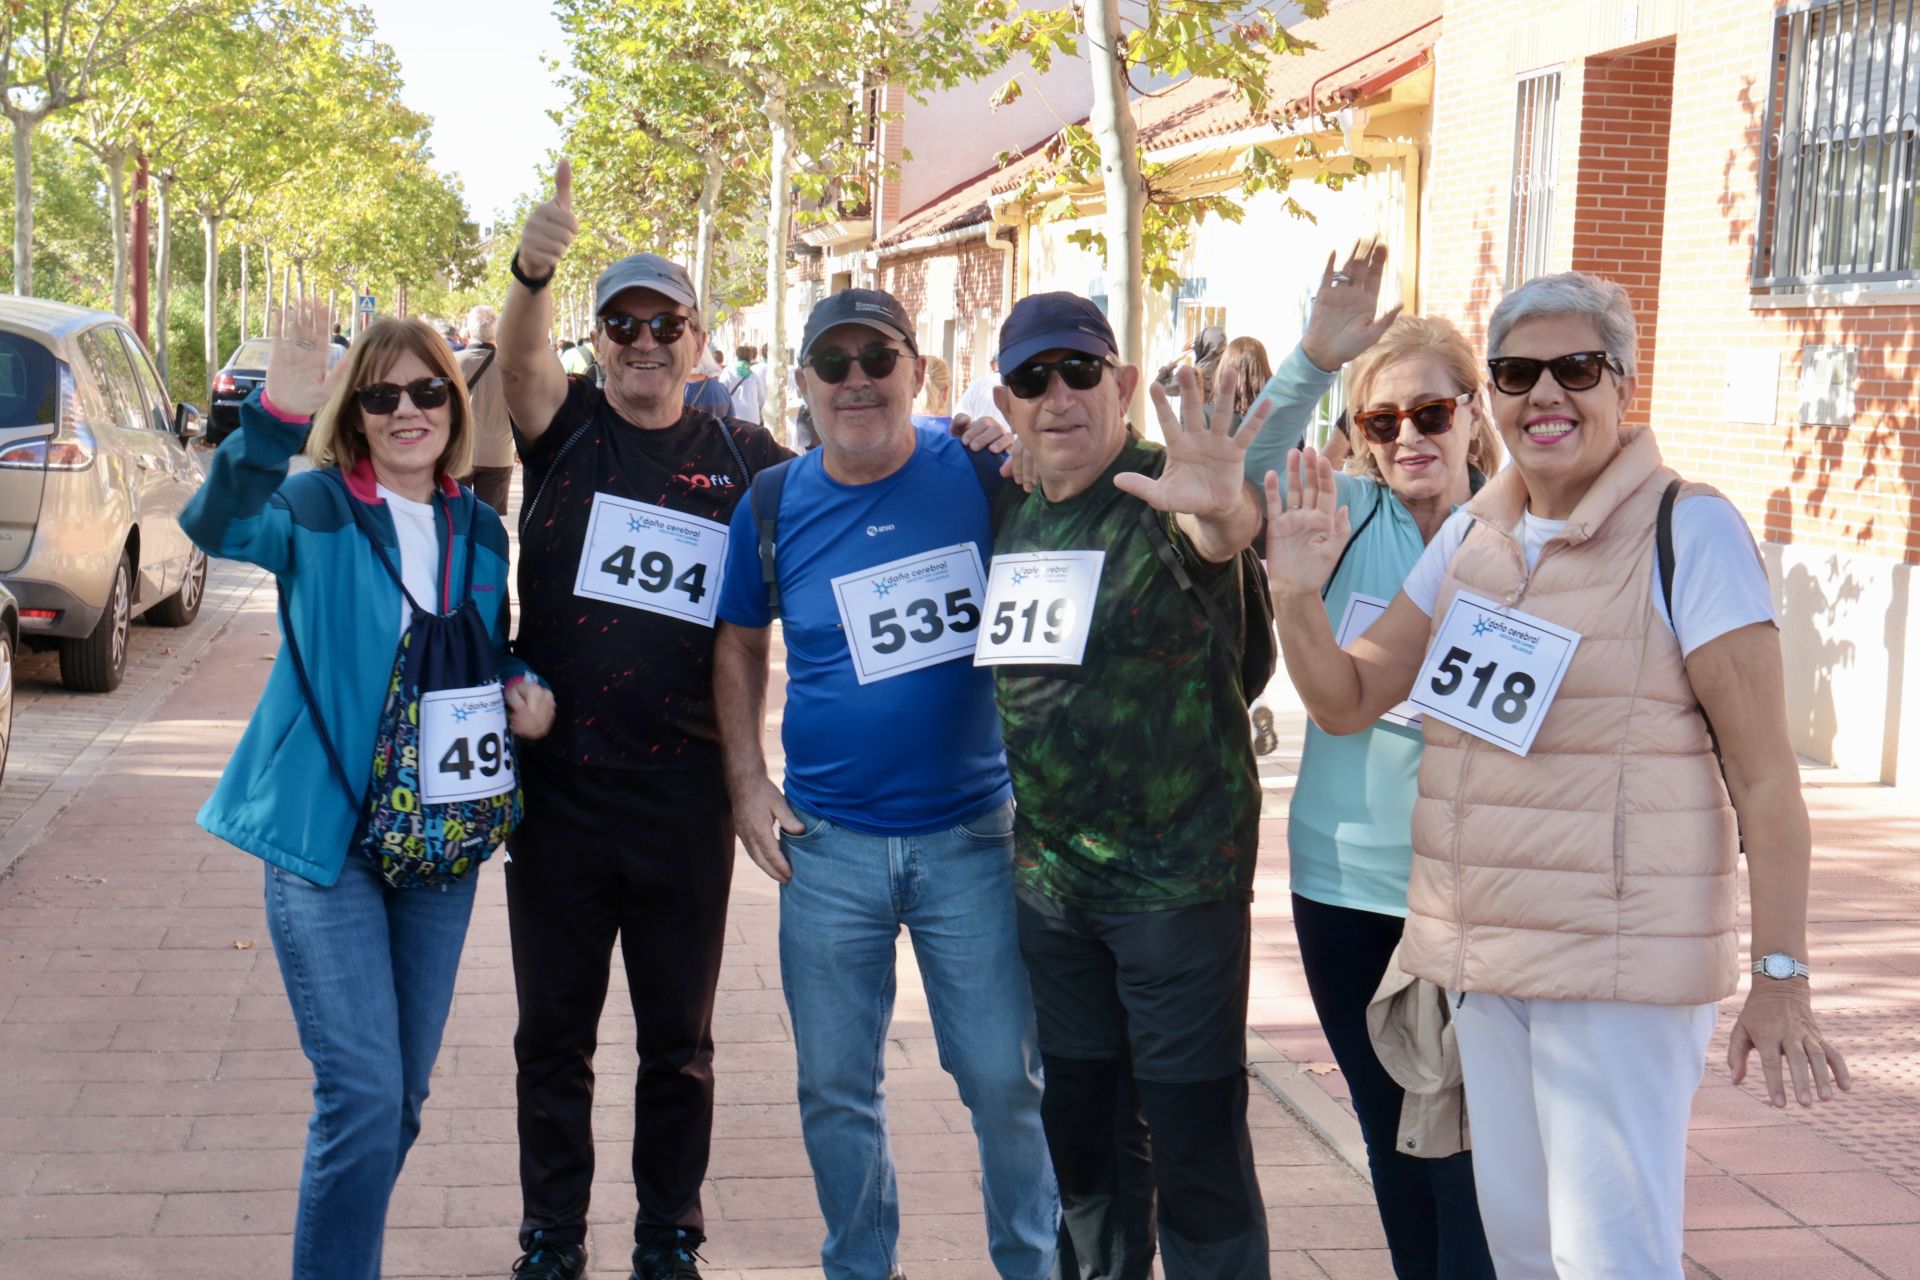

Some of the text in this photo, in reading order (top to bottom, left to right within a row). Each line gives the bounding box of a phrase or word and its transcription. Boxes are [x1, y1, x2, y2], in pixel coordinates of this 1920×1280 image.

[643, 517, 665, 529] daño
[666, 524, 701, 538] cerebral
[600, 544, 707, 604] 494
[887, 573, 910, 584] daño
[911, 561, 948, 577] cerebral
[869, 587, 981, 655] 535
[990, 598, 1076, 645] 519
[1487, 620, 1507, 632] daño
[1508, 628, 1541, 645] cerebral
[1431, 645, 1536, 724] 518
